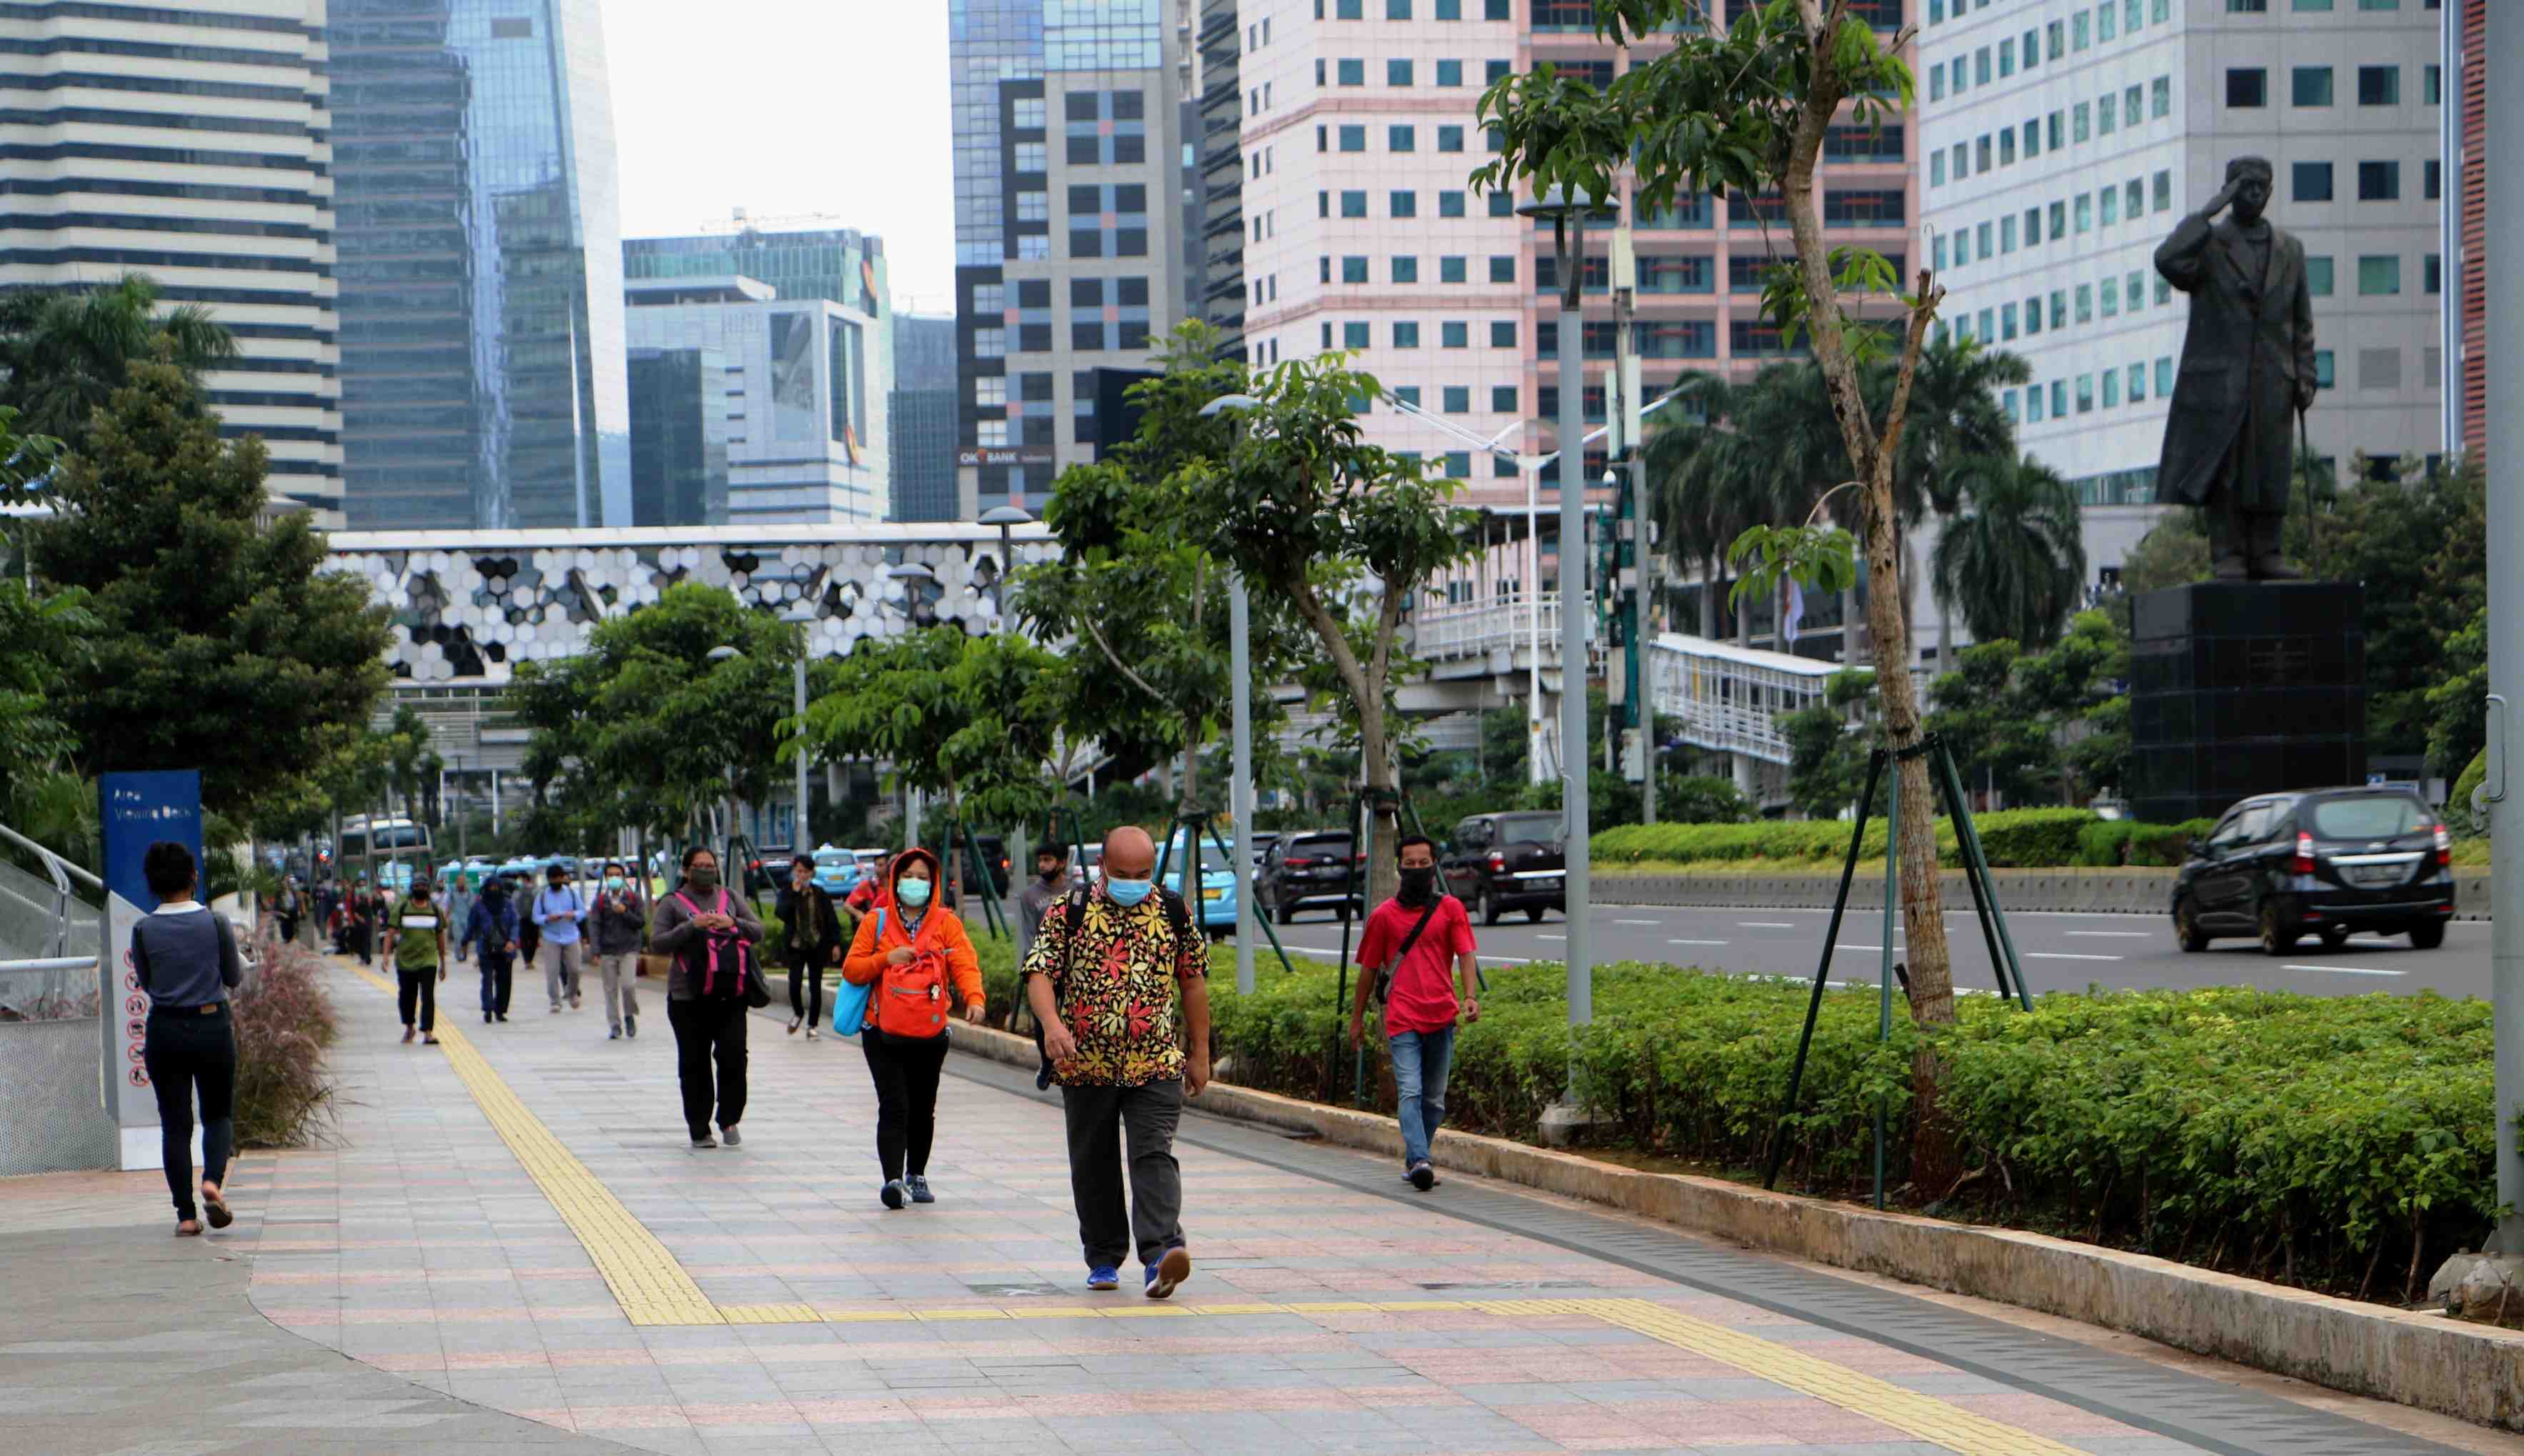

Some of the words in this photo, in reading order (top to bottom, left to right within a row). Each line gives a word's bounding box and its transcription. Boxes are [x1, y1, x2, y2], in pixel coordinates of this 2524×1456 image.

[960, 452, 978, 463] OK
[986, 451, 1017, 463] BANK
[114, 788, 141, 800] Area
